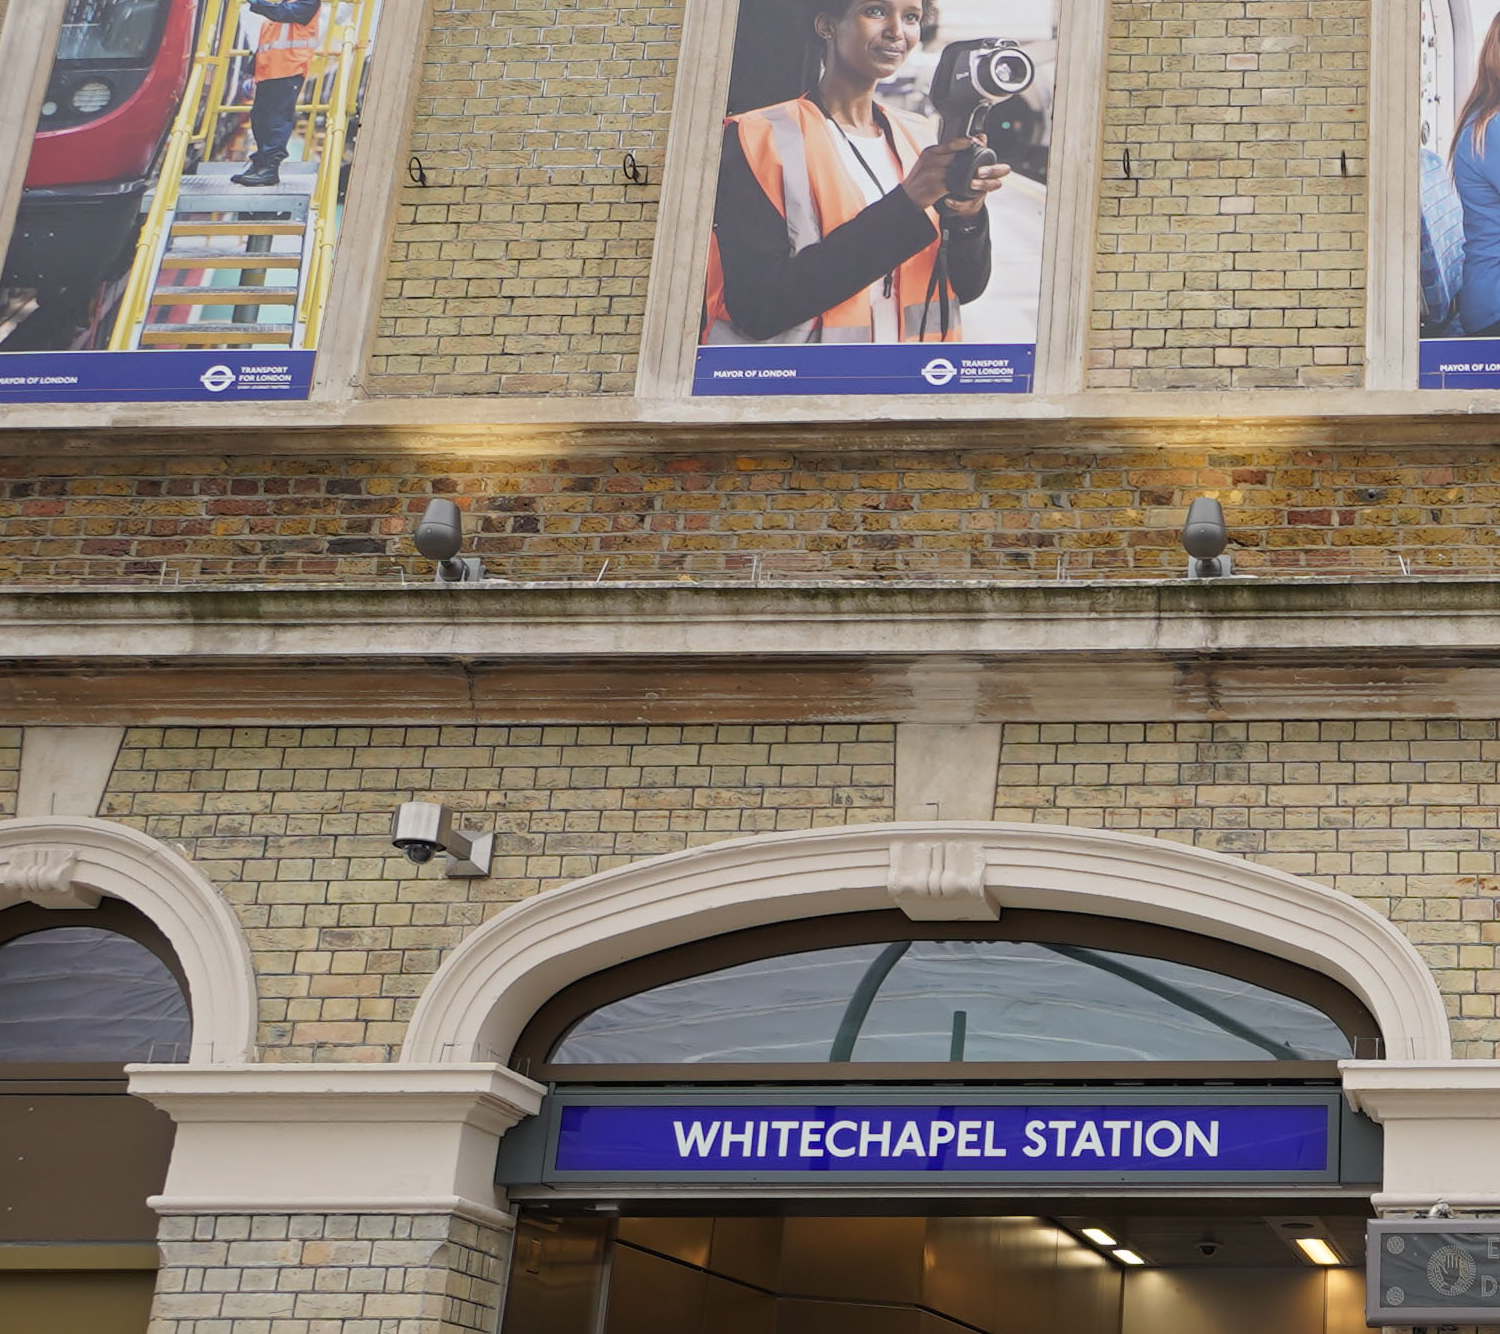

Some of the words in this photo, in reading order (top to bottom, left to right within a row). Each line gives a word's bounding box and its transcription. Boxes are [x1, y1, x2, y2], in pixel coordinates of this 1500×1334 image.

[961, 359, 1009, 367] TRANSPORT
[1440, 364, 1470, 372] MAYOR
[1471, 364, 1484, 372] OF
[713, 370, 743, 378] MAYOR
[744, 370, 757, 378] OF
[758, 369, 797, 378] LONDON
[26, 376, 40, 385] OF
[40, 376, 78, 384] LONDON
[238, 374, 255, 382] FOR
[257, 374, 292, 382] LONDON
[674, 1121, 1006, 1157] WHITECHAPEL
[1023, 1120, 1218, 1157] STATION
